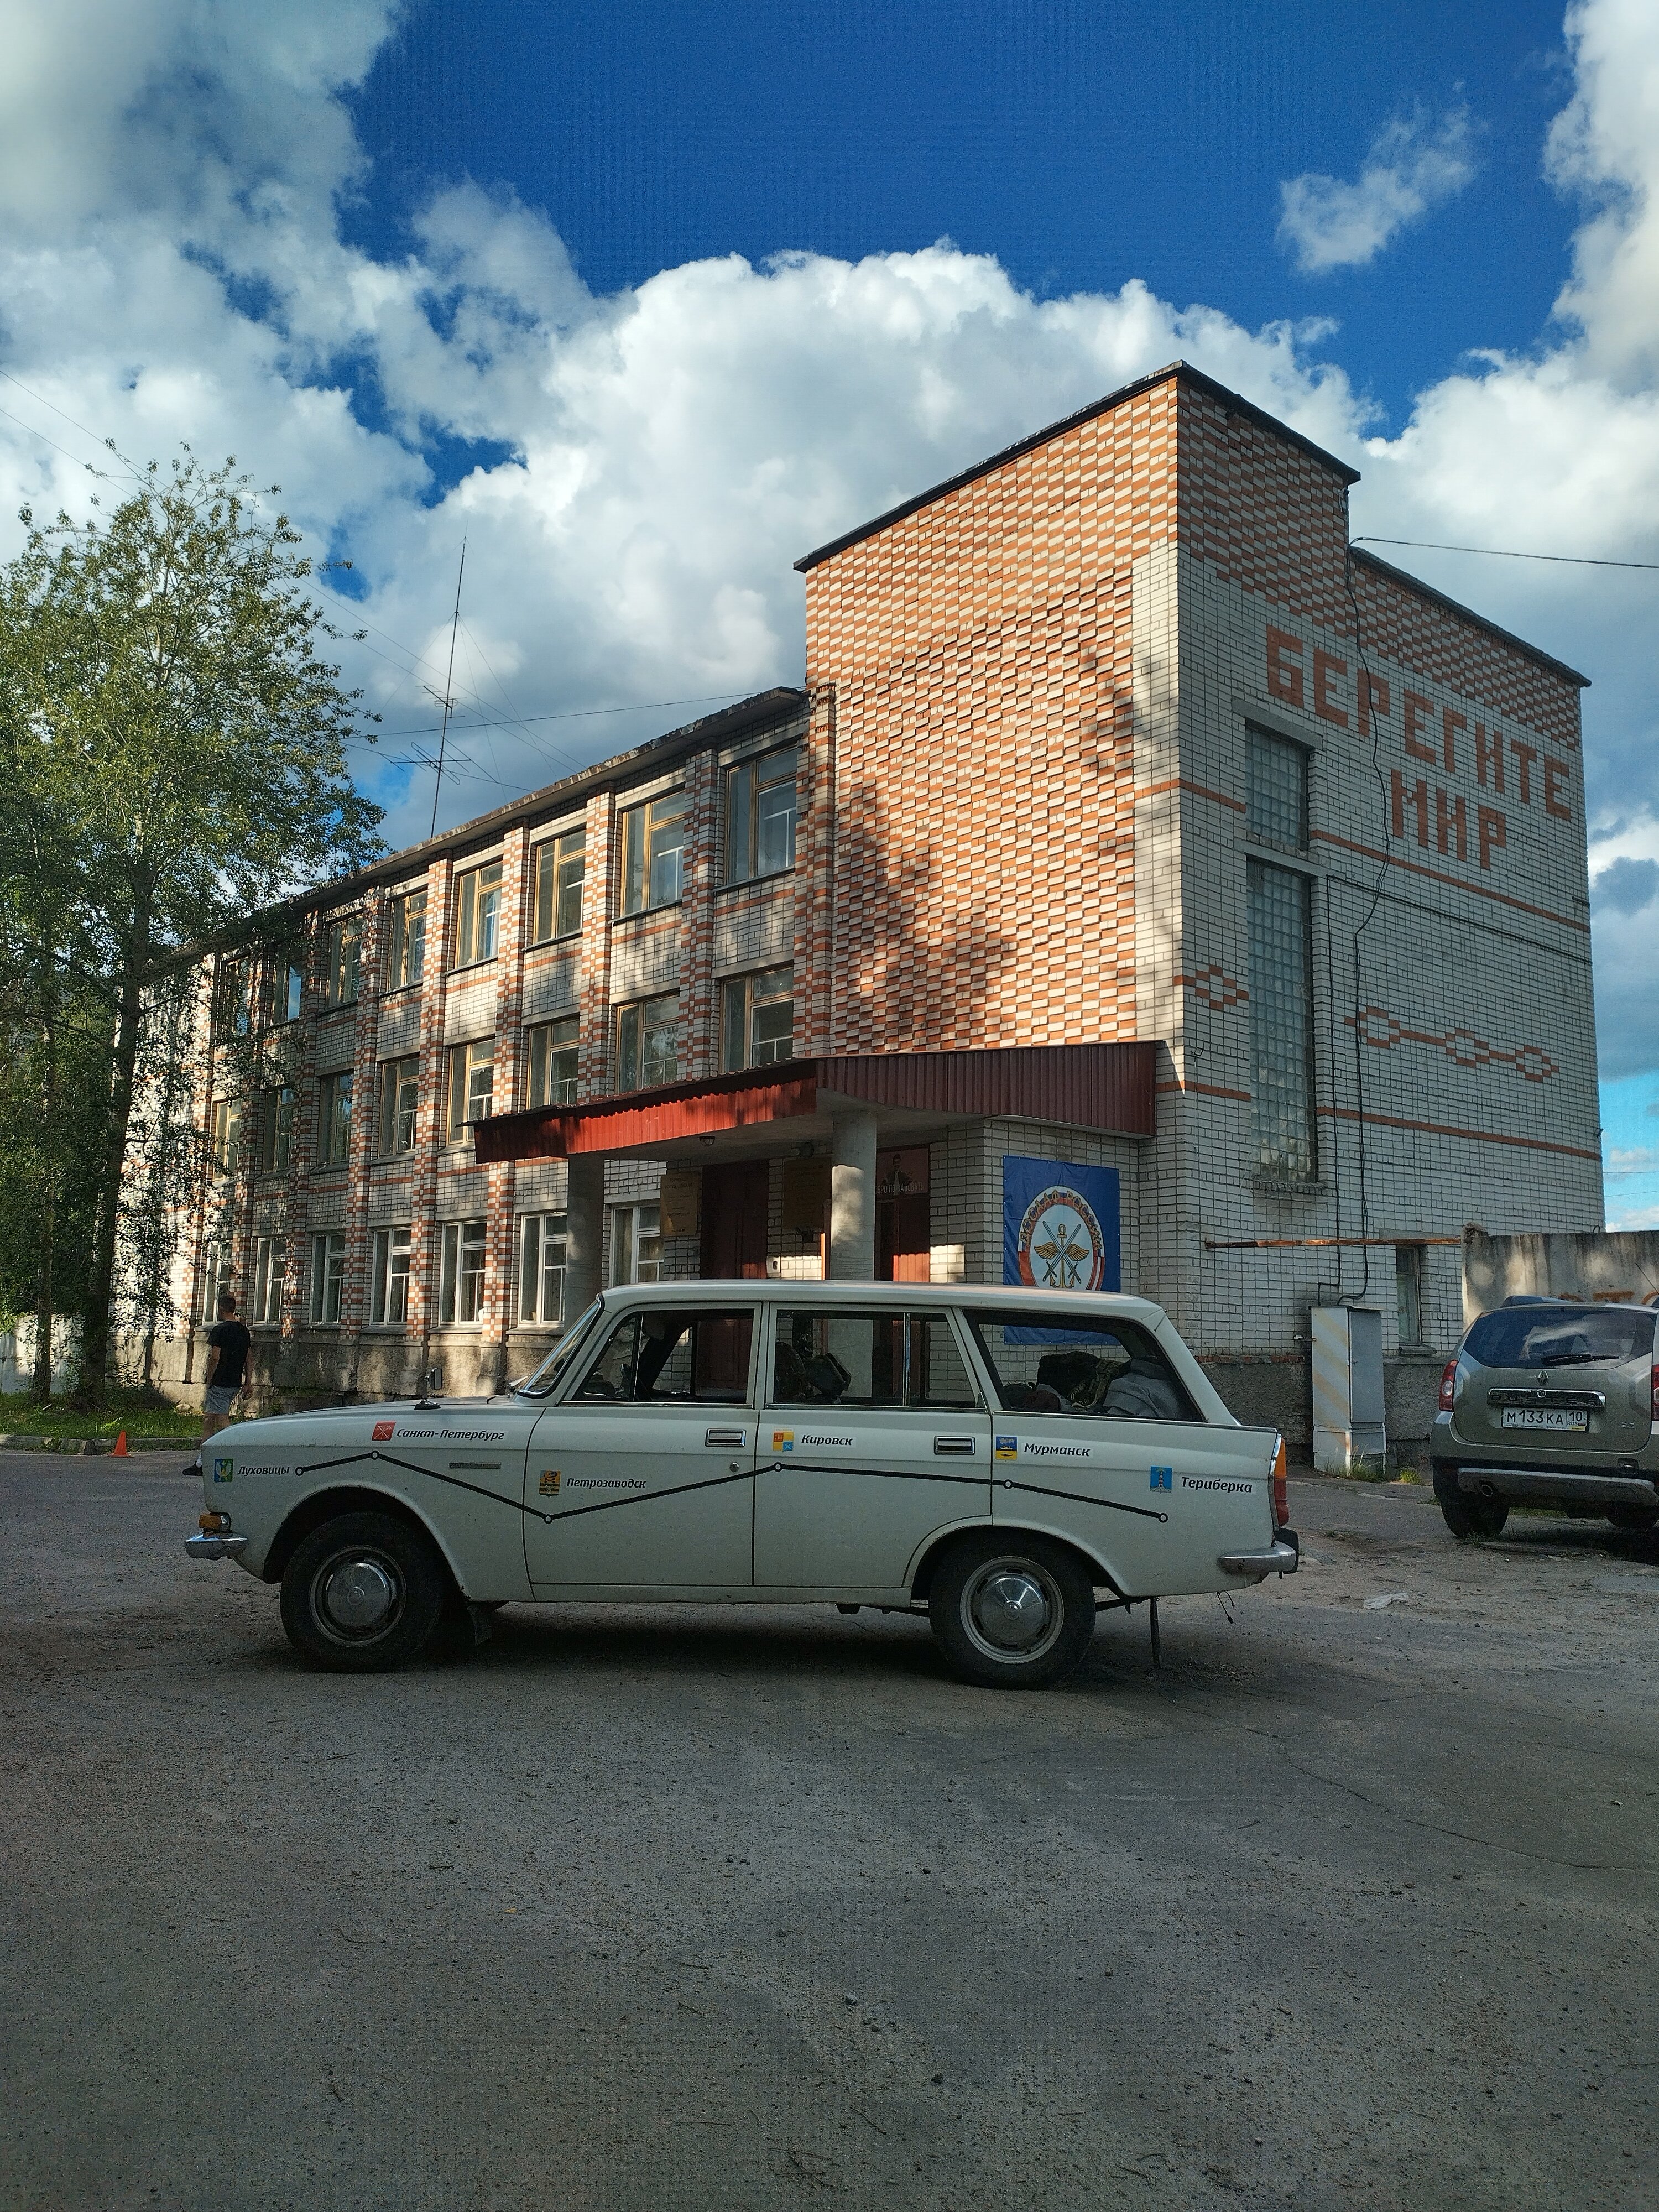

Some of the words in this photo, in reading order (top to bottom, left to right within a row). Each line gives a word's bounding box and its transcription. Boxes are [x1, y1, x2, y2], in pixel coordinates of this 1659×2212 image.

[1266, 624, 1572, 822] БЕРЕГИТЕ
[1390, 769, 1507, 870] МИР
[1569, 1411, 1583, 1422] 10
[397, 1428, 505, 1441] Санкт-Петербург
[801, 1434, 853, 1446] Кировск
[1024, 1443, 1091, 1457] Мурманск
[237, 1465, 290, 1477] Луховицы
[566, 1478, 646, 1489] Петрозаводск
[1181, 1477, 1253, 1493] Териберка
